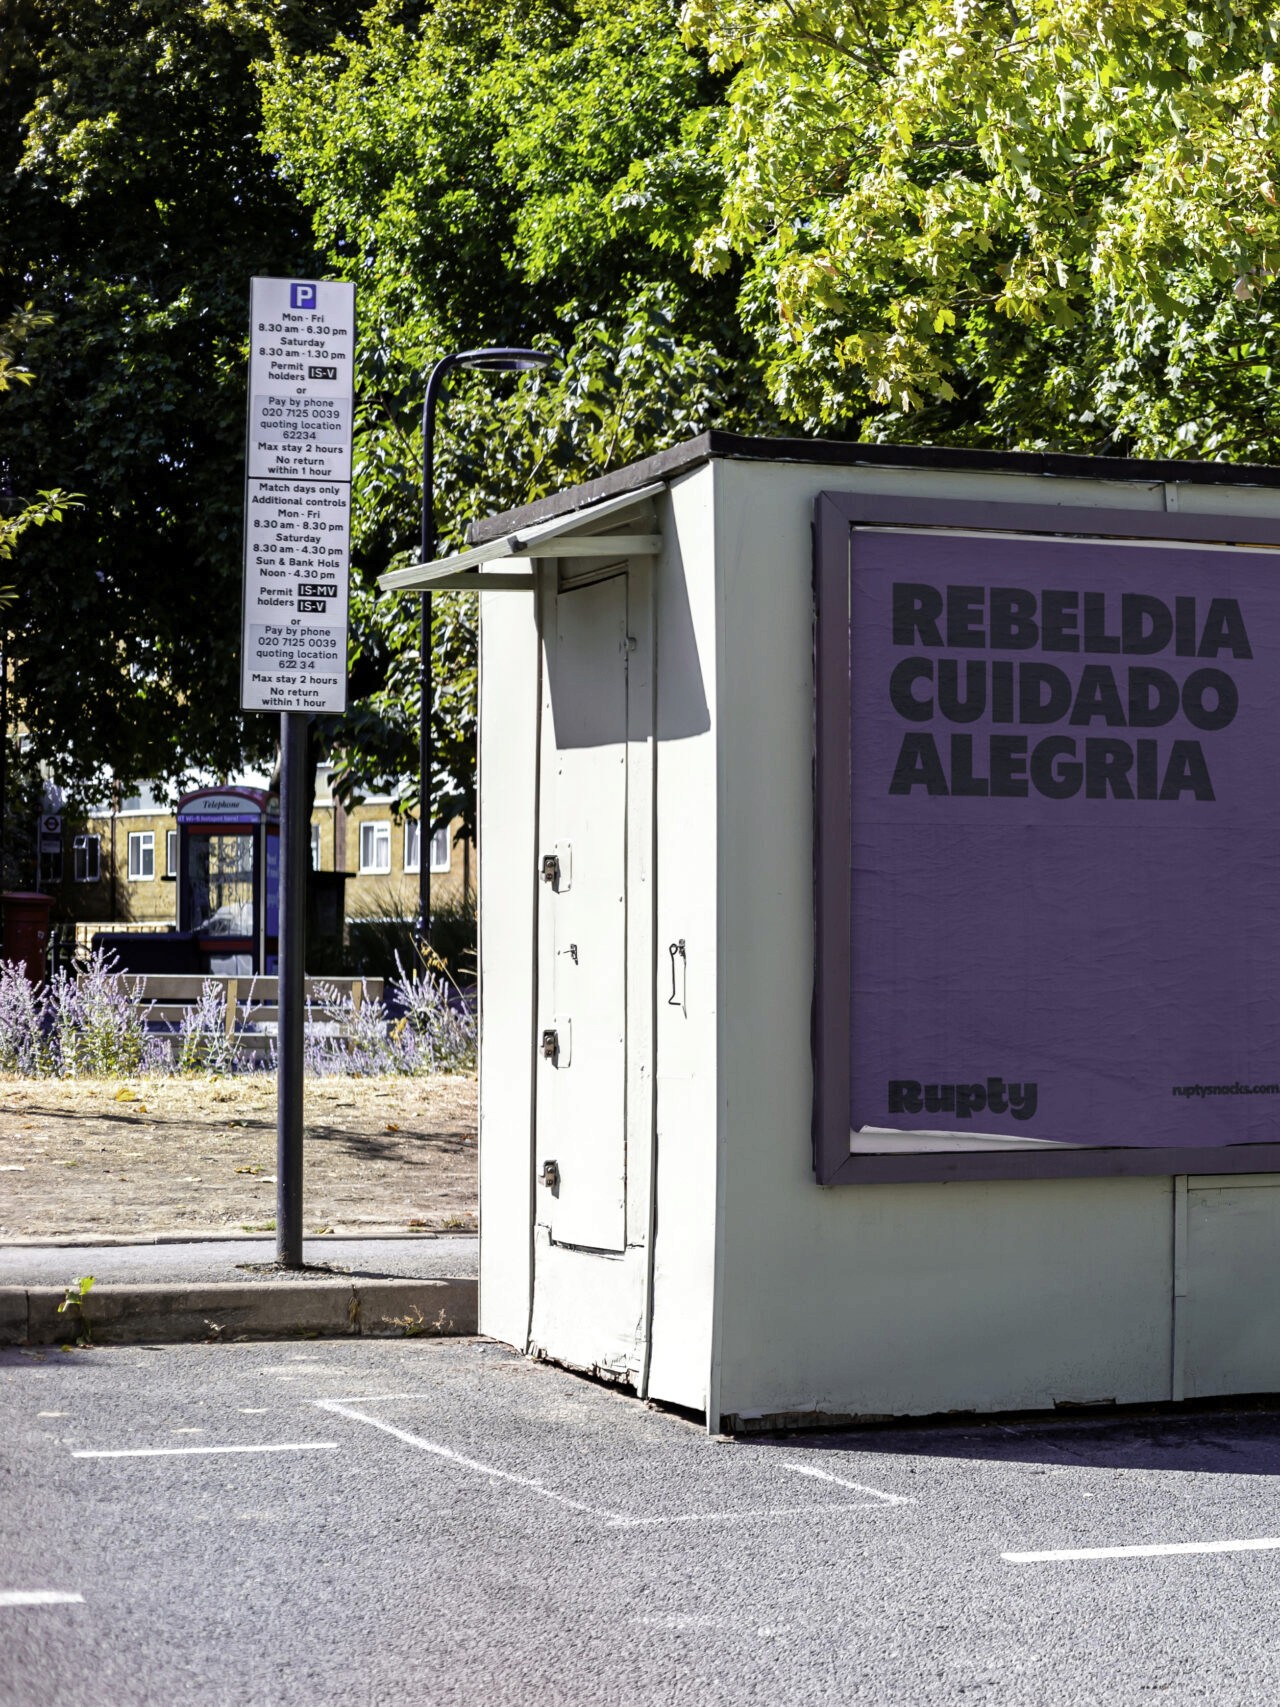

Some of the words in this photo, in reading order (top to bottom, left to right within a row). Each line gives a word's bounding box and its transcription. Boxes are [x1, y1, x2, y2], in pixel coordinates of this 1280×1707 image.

[296, 286, 312, 306] P
[282, 313, 303, 321] Mon
[259, 324, 282, 332] 8.30
[307, 326, 330, 334] 6.30
[333, 328, 347, 336] pm
[280, 337, 325, 348] Saturday
[259, 348, 282, 356] 8.30
[308, 350, 328, 358] 1.30
[331, 352, 345, 360] pm
[271, 361, 303, 370] Permit
[269, 372, 305, 380] holders
[311, 369, 334, 377] IS-V
[269, 397, 286, 406] Pay
[290, 398, 300, 407] by
[304, 399, 334, 407] phone
[262, 408, 282, 416] 020
[287, 409, 308, 418] 7125
[312, 410, 339, 418] 0039
[260, 421, 297, 430] quoting
[302, 421, 341, 430] location
[283, 431, 316, 439] 62234
[258, 442, 278, 450] Max
[282, 444, 302, 453] stay
[306, 444, 311, 452] 2
[316, 445, 343, 453] hours
[260, 483, 290, 492] Match
[294, 485, 315, 494] days
[320, 486, 339, 495] only
[252, 496, 302, 505] Additional
[306, 499, 346, 507] controls
[278, 509, 299, 517] Mon
[307, 510, 320, 518] Fri
[254, 520, 277, 528] 8.30
[303, 522, 326, 530] 8.30
[329, 524, 343, 532] pm
[276, 534, 321, 544] Saturday
[253, 544, 277, 552] 8.30
[302, 546, 325, 554] 4.30
[328, 548, 342, 556] pm
[256, 557, 275, 565] Sun
[289, 559, 313, 567] Bank
[318, 559, 339, 567] Hols
[260, 569, 285, 577] Noon
[294, 570, 317, 578] 4.30
[320, 572, 335, 580] pm
[260, 587, 292, 596] Permit
[301, 586, 335, 595] IS-MV
[258, 597, 294, 606] holders
[301, 602, 324, 611] IS-V
[893, 582, 1253, 660] REBELDIA
[265, 626, 282, 635] Pay
[286, 627, 297, 636] by
[301, 628, 330, 637] phone
[258, 637, 279, 646] 020
[283, 638, 305, 646] 7125
[309, 639, 336, 647] 0039
[256, 650, 294, 659] quoting
[297, 650, 337, 659] location
[252, 674, 272, 682] Max
[276, 675, 296, 684] stay
[310, 676, 337, 684] hours
[889, 656, 1239, 731] CUIDADO
[262, 698, 292, 706] within
[304, 699, 325, 707] hour
[889, 732, 1216, 801] ALEGRIA
[203, 801, 240, 809] Telephone
[888, 1077, 1037, 1120] Rupty
